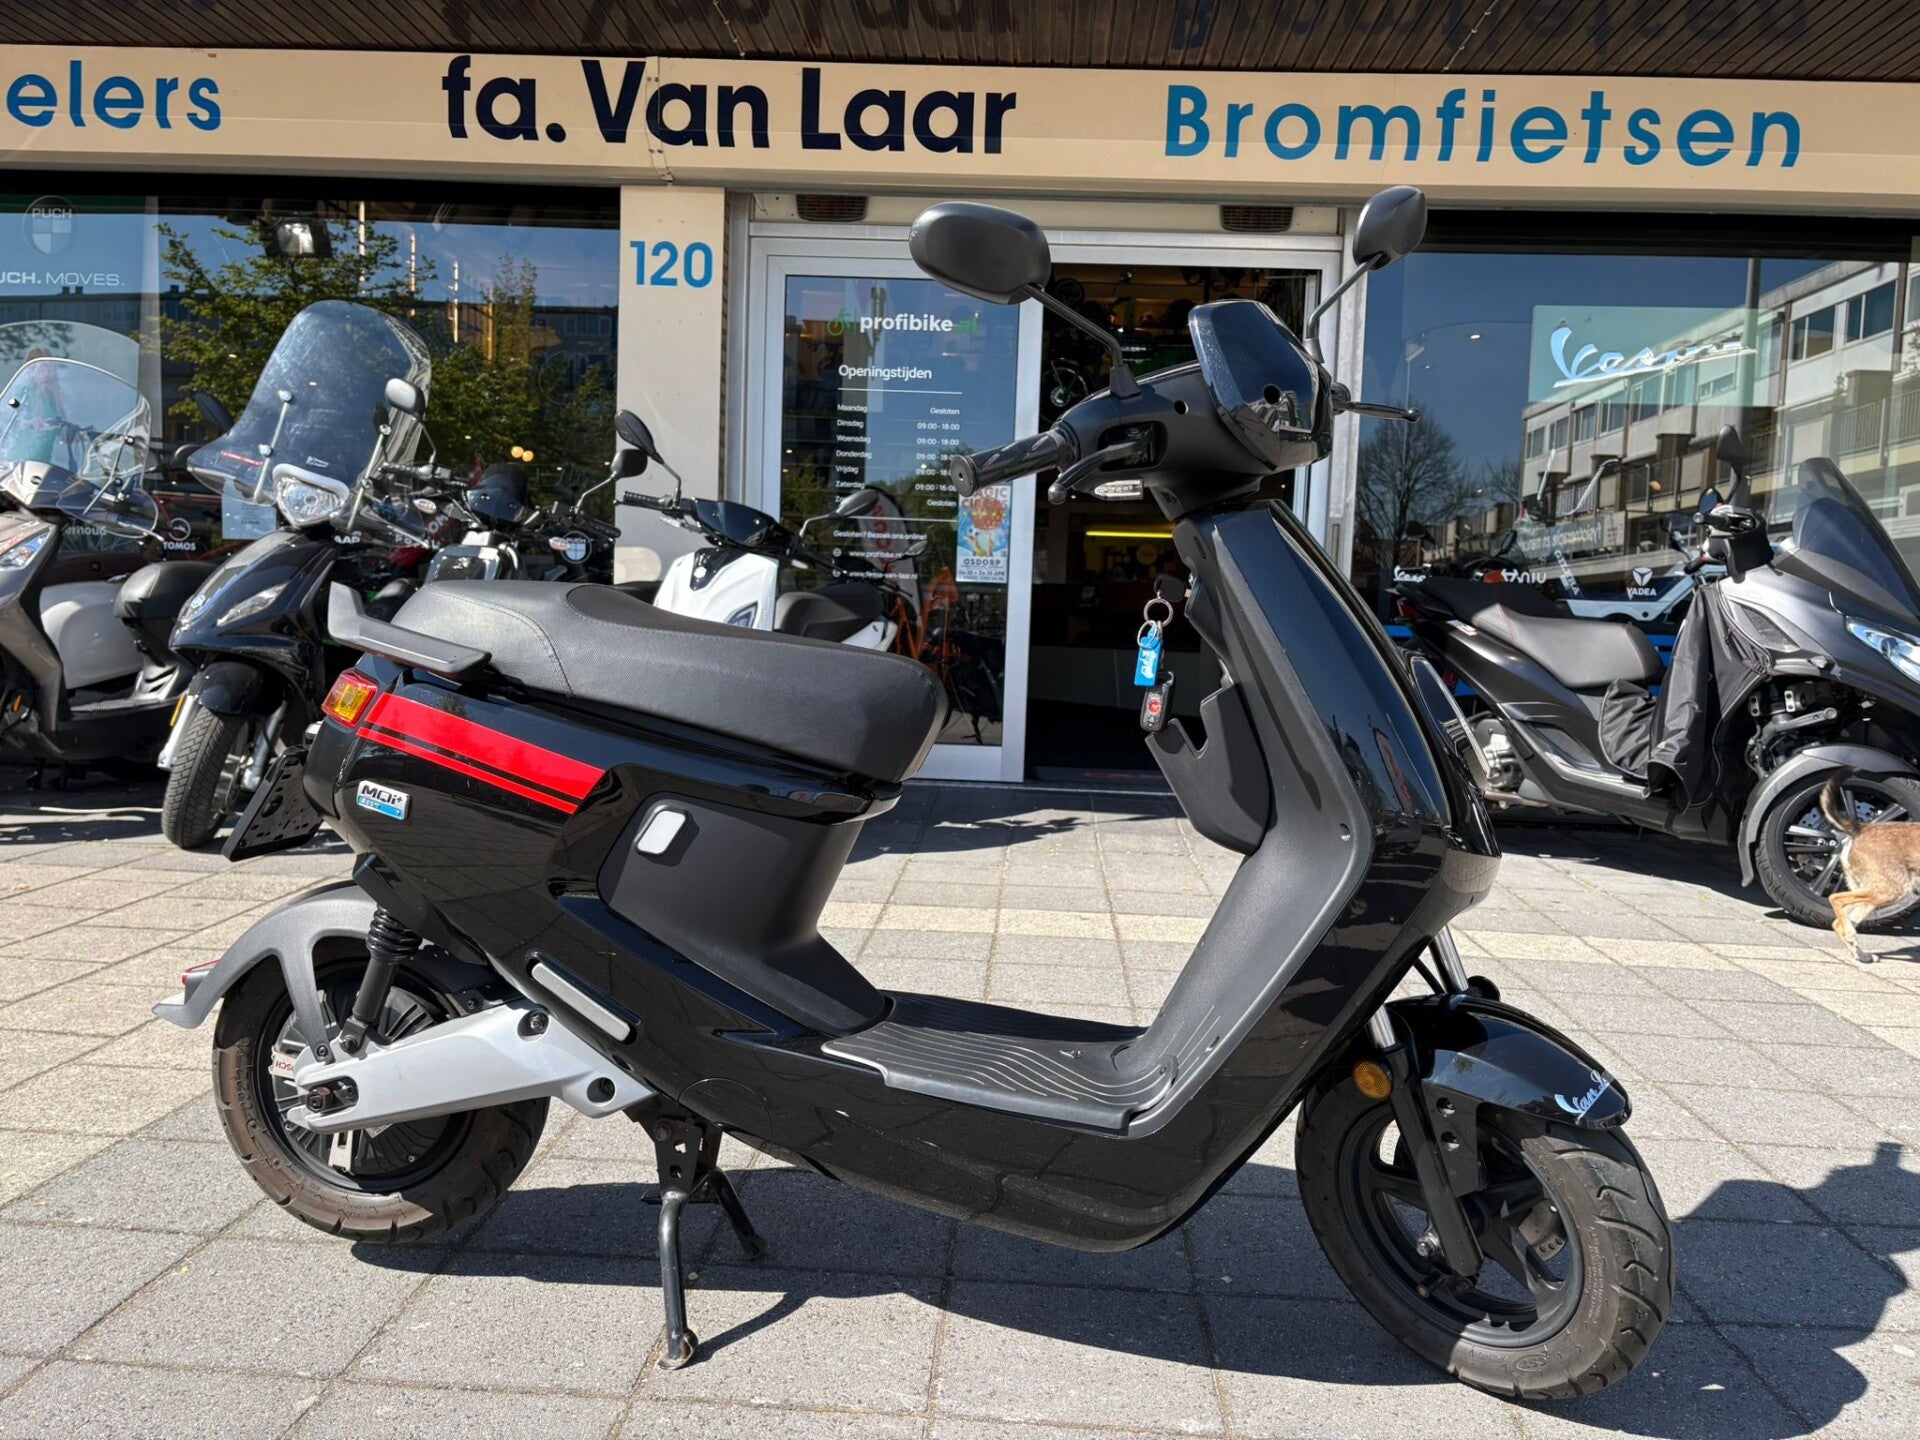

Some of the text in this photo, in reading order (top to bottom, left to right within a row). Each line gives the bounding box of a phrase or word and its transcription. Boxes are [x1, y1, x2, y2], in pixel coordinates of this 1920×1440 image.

[7, 60, 221, 130] elers
[442, 55, 1017, 154] fa. Van Laar
[1165, 85, 1801, 167] Bromfietsen
[32, 208, 72, 219] PUCH
[628, 240, 713, 287] 120
[46, 272, 125, 286] MOVES.
[838, 364, 933, 381] Openingstijden
[837, 404, 960, 415] Maandag Gesloten
[837, 420, 864, 428] Dinsdag
[836, 435, 871, 444] Woensdag
[836, 450, 872, 459] Donderdag
[836, 465, 859, 474] Vrijdag
[835, 481, 865, 490] Zaterdag
[927, 499, 957, 507] Gesloten
[834, 530, 866, 538] Gesloten?
[867, 531, 891, 539] Bezoek
[163, 541, 196, 551] TOMOS
[963, 558, 1001, 566] OSDORP
[1626, 587, 1657, 597] YADEA
